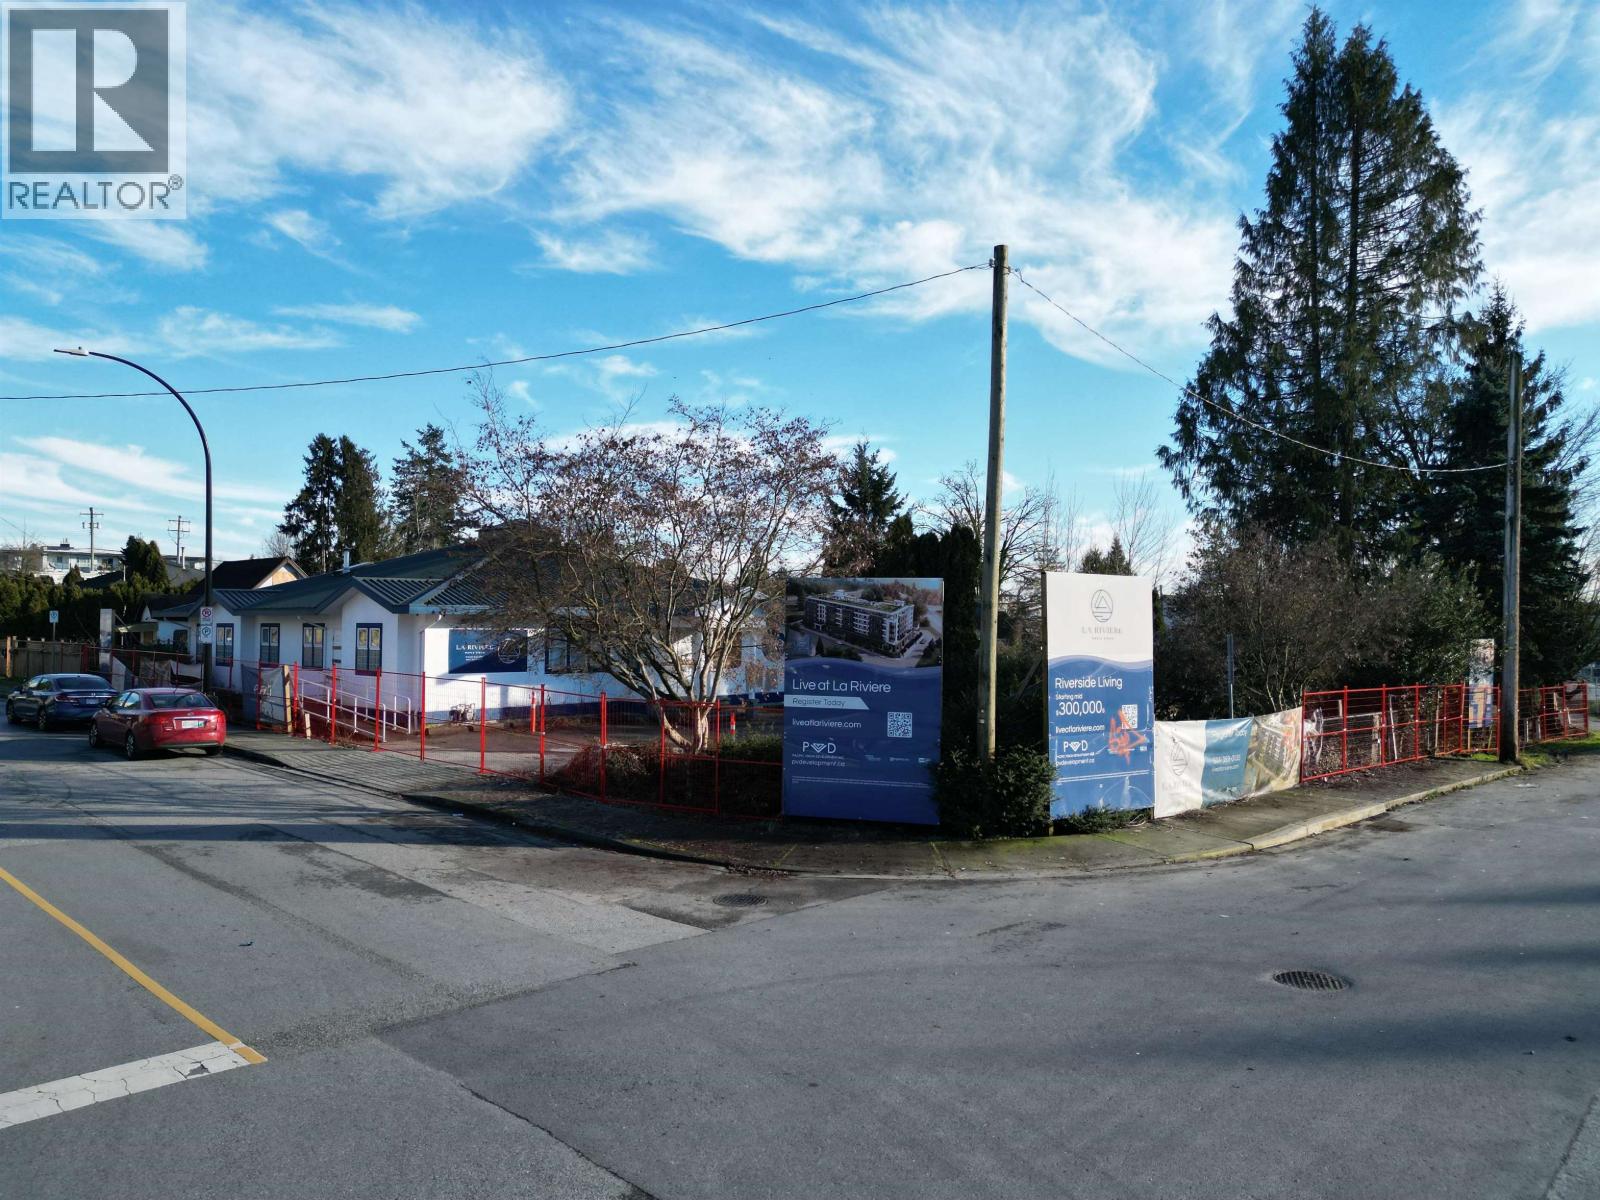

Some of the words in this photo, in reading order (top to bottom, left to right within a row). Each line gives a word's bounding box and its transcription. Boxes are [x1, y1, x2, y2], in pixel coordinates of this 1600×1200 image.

[792, 678, 817, 691] Live
[817, 679, 831, 692] at
[832, 680, 848, 692] La
[850, 680, 892, 693] Riviere
[1055, 676, 1097, 689] Riverside
[1098, 676, 1123, 690] Living
[792, 697, 823, 706] Register
[824, 698, 846, 708] Today
